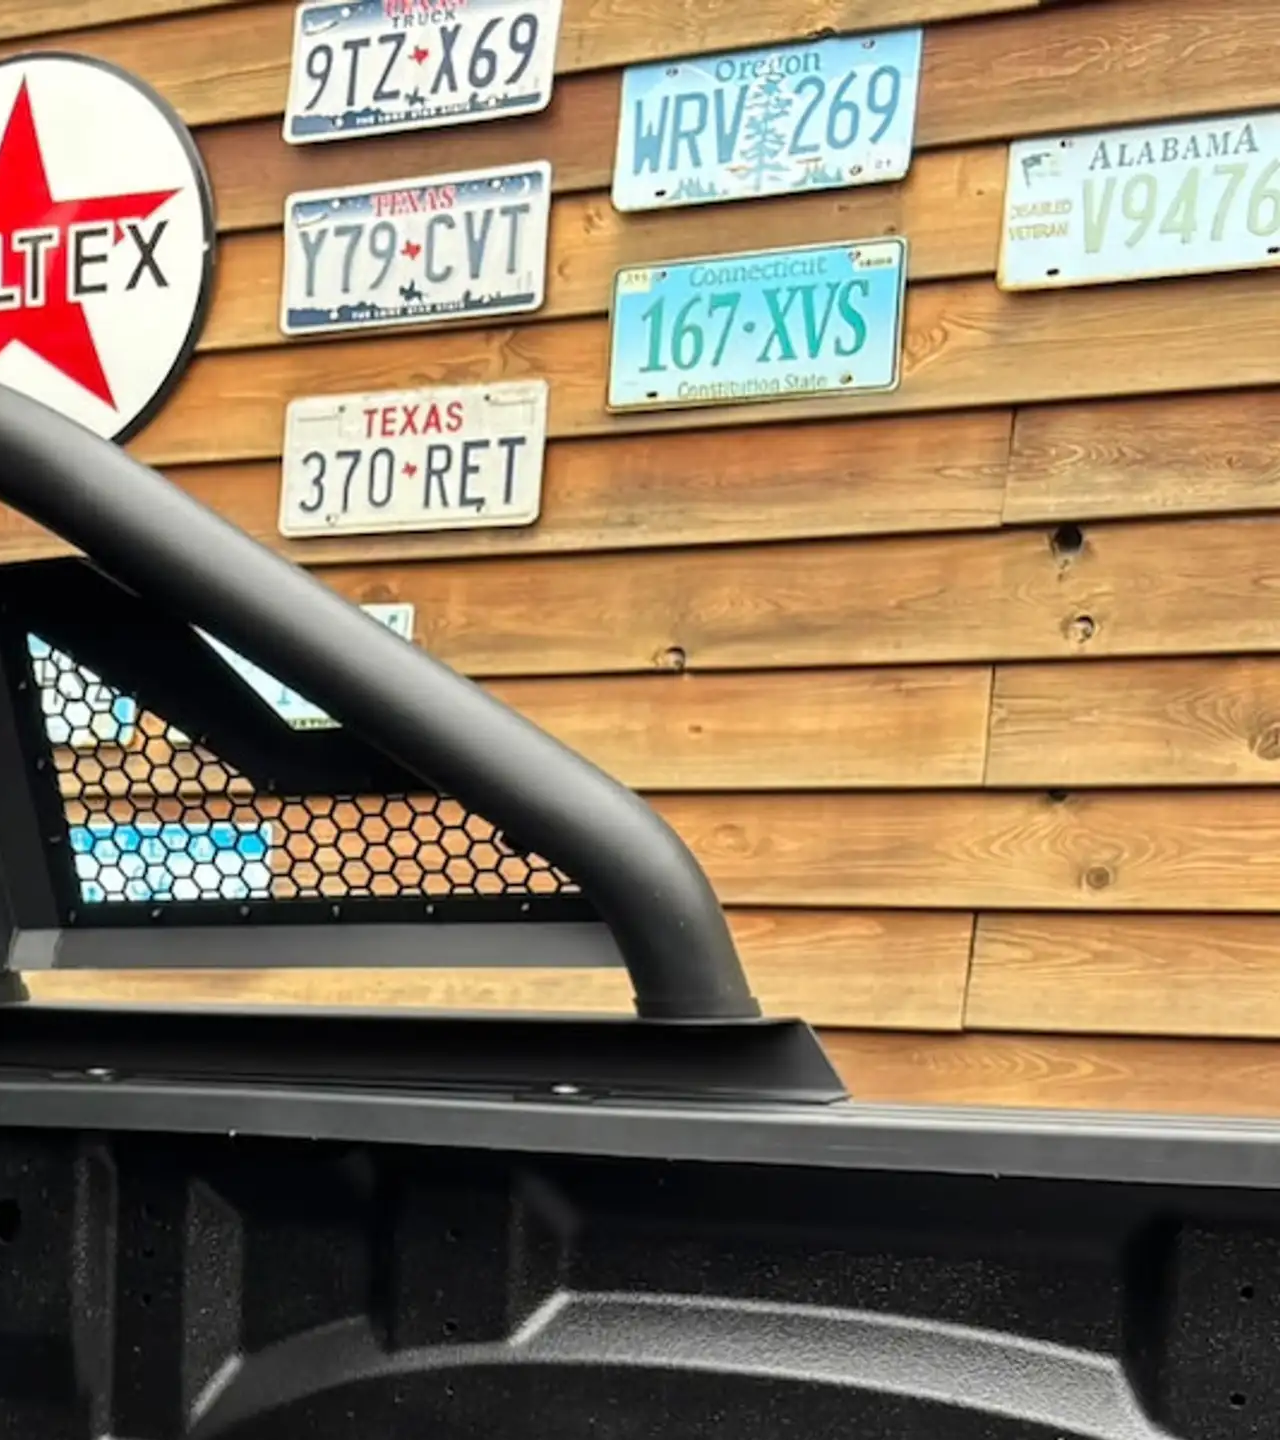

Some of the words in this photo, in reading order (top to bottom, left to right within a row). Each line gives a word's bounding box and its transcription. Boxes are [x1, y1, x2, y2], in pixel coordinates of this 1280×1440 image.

[391, 7, 457, 29] TRUCK
[714, 51, 822, 83] Oregon
[1088, 122, 1260, 171] ALABAMA
[372, 185, 458, 218] TEXAS
[689, 255, 828, 288] Connecticut
[676, 376, 781, 400] Constitution
[783, 371, 828, 393] State
[362, 400, 464, 439] TEXAS
